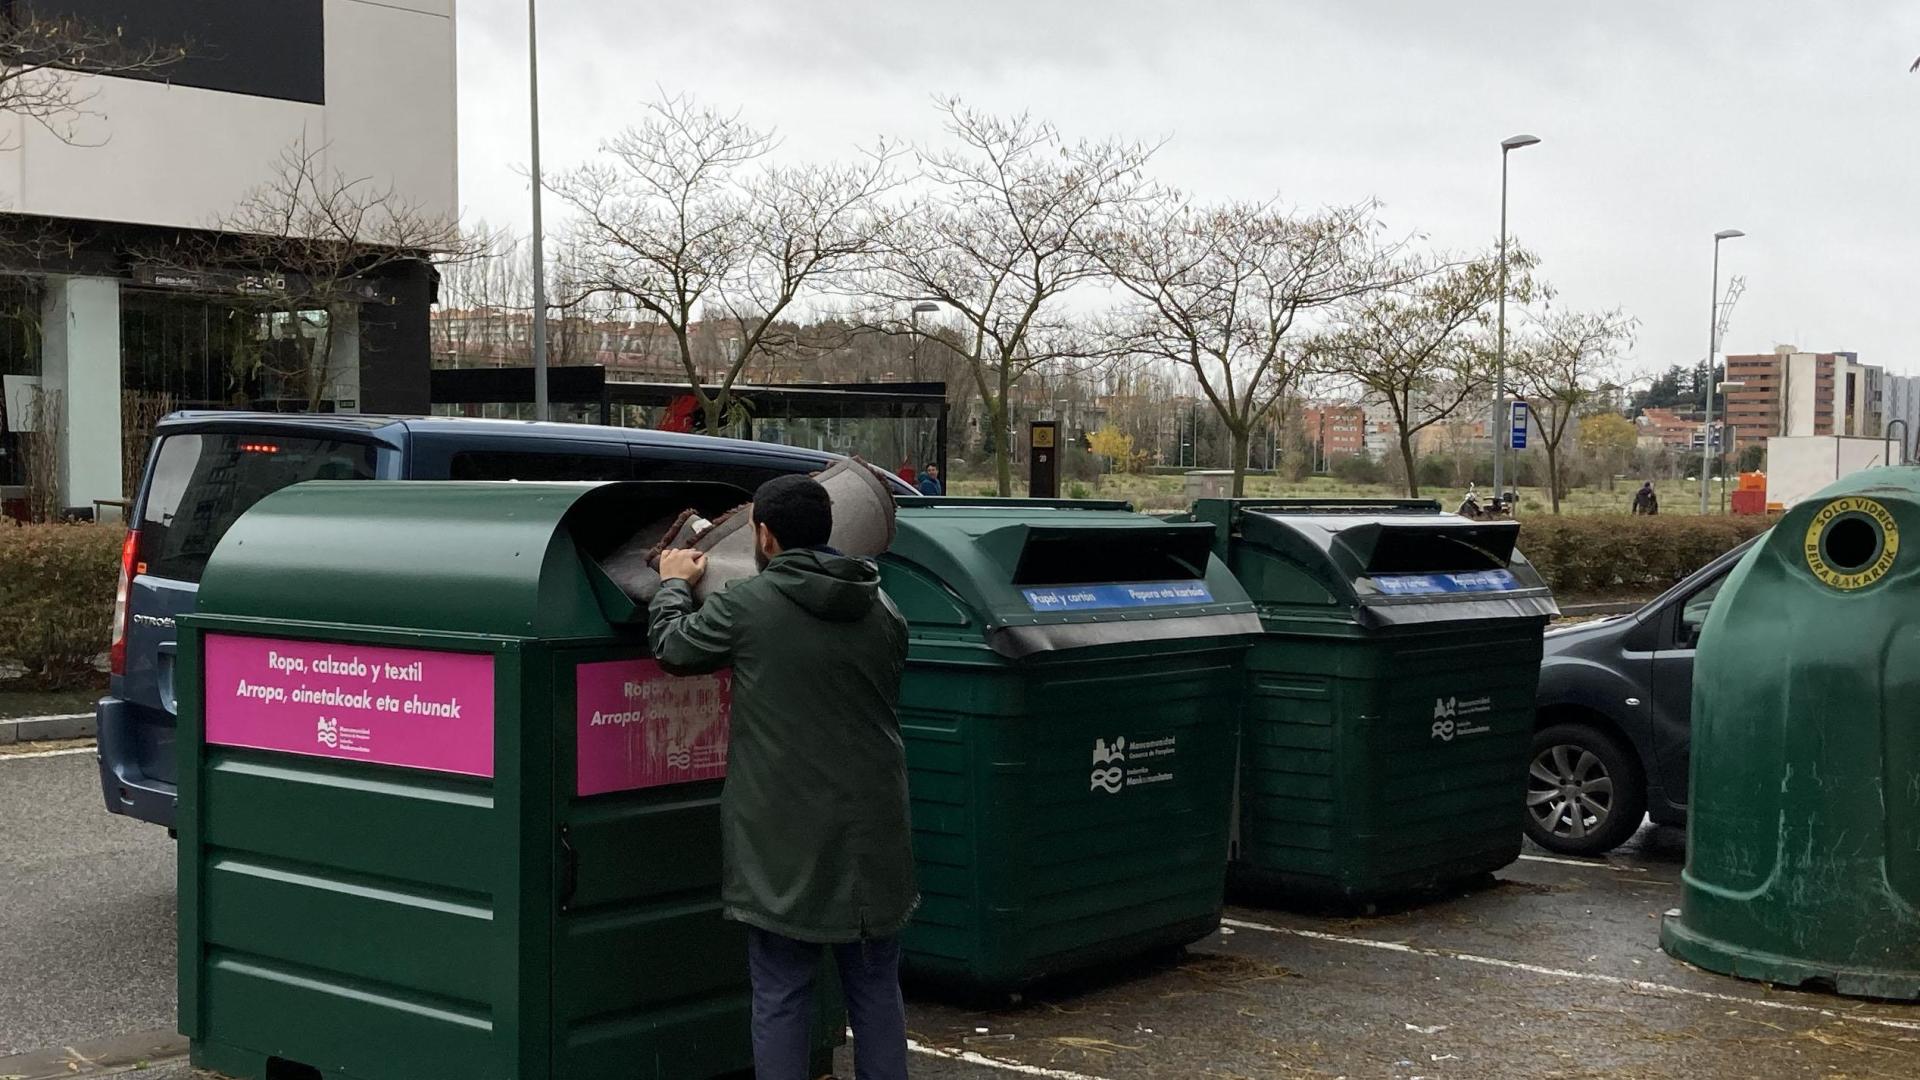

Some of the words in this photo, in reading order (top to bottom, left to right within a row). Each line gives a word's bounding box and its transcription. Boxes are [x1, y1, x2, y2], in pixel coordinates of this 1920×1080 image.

[1817, 501, 1849, 526] SOLO
[1855, 499, 1896, 532] VIDRIO
[1807, 544, 1829, 578] BEIRA
[1831, 549, 1895, 587] BAKARRIK
[1030, 591, 1059, 606] Papel
[1058, 594, 1067, 606] y
[1127, 589, 1161, 602] Papera
[1160, 588, 1174, 598] eta
[268, 651, 308, 675] Ropa,
[312, 654, 367, 677] calzado
[371, 664, 381, 683] y
[384, 661, 422, 681] textil
[236, 679, 288, 704] Arropa,
[292, 684, 372, 709] oinetakoak
[376, 695, 399, 713] eta
[403, 694, 461, 718] ehunak
[590, 711, 644, 727] Arropa,
